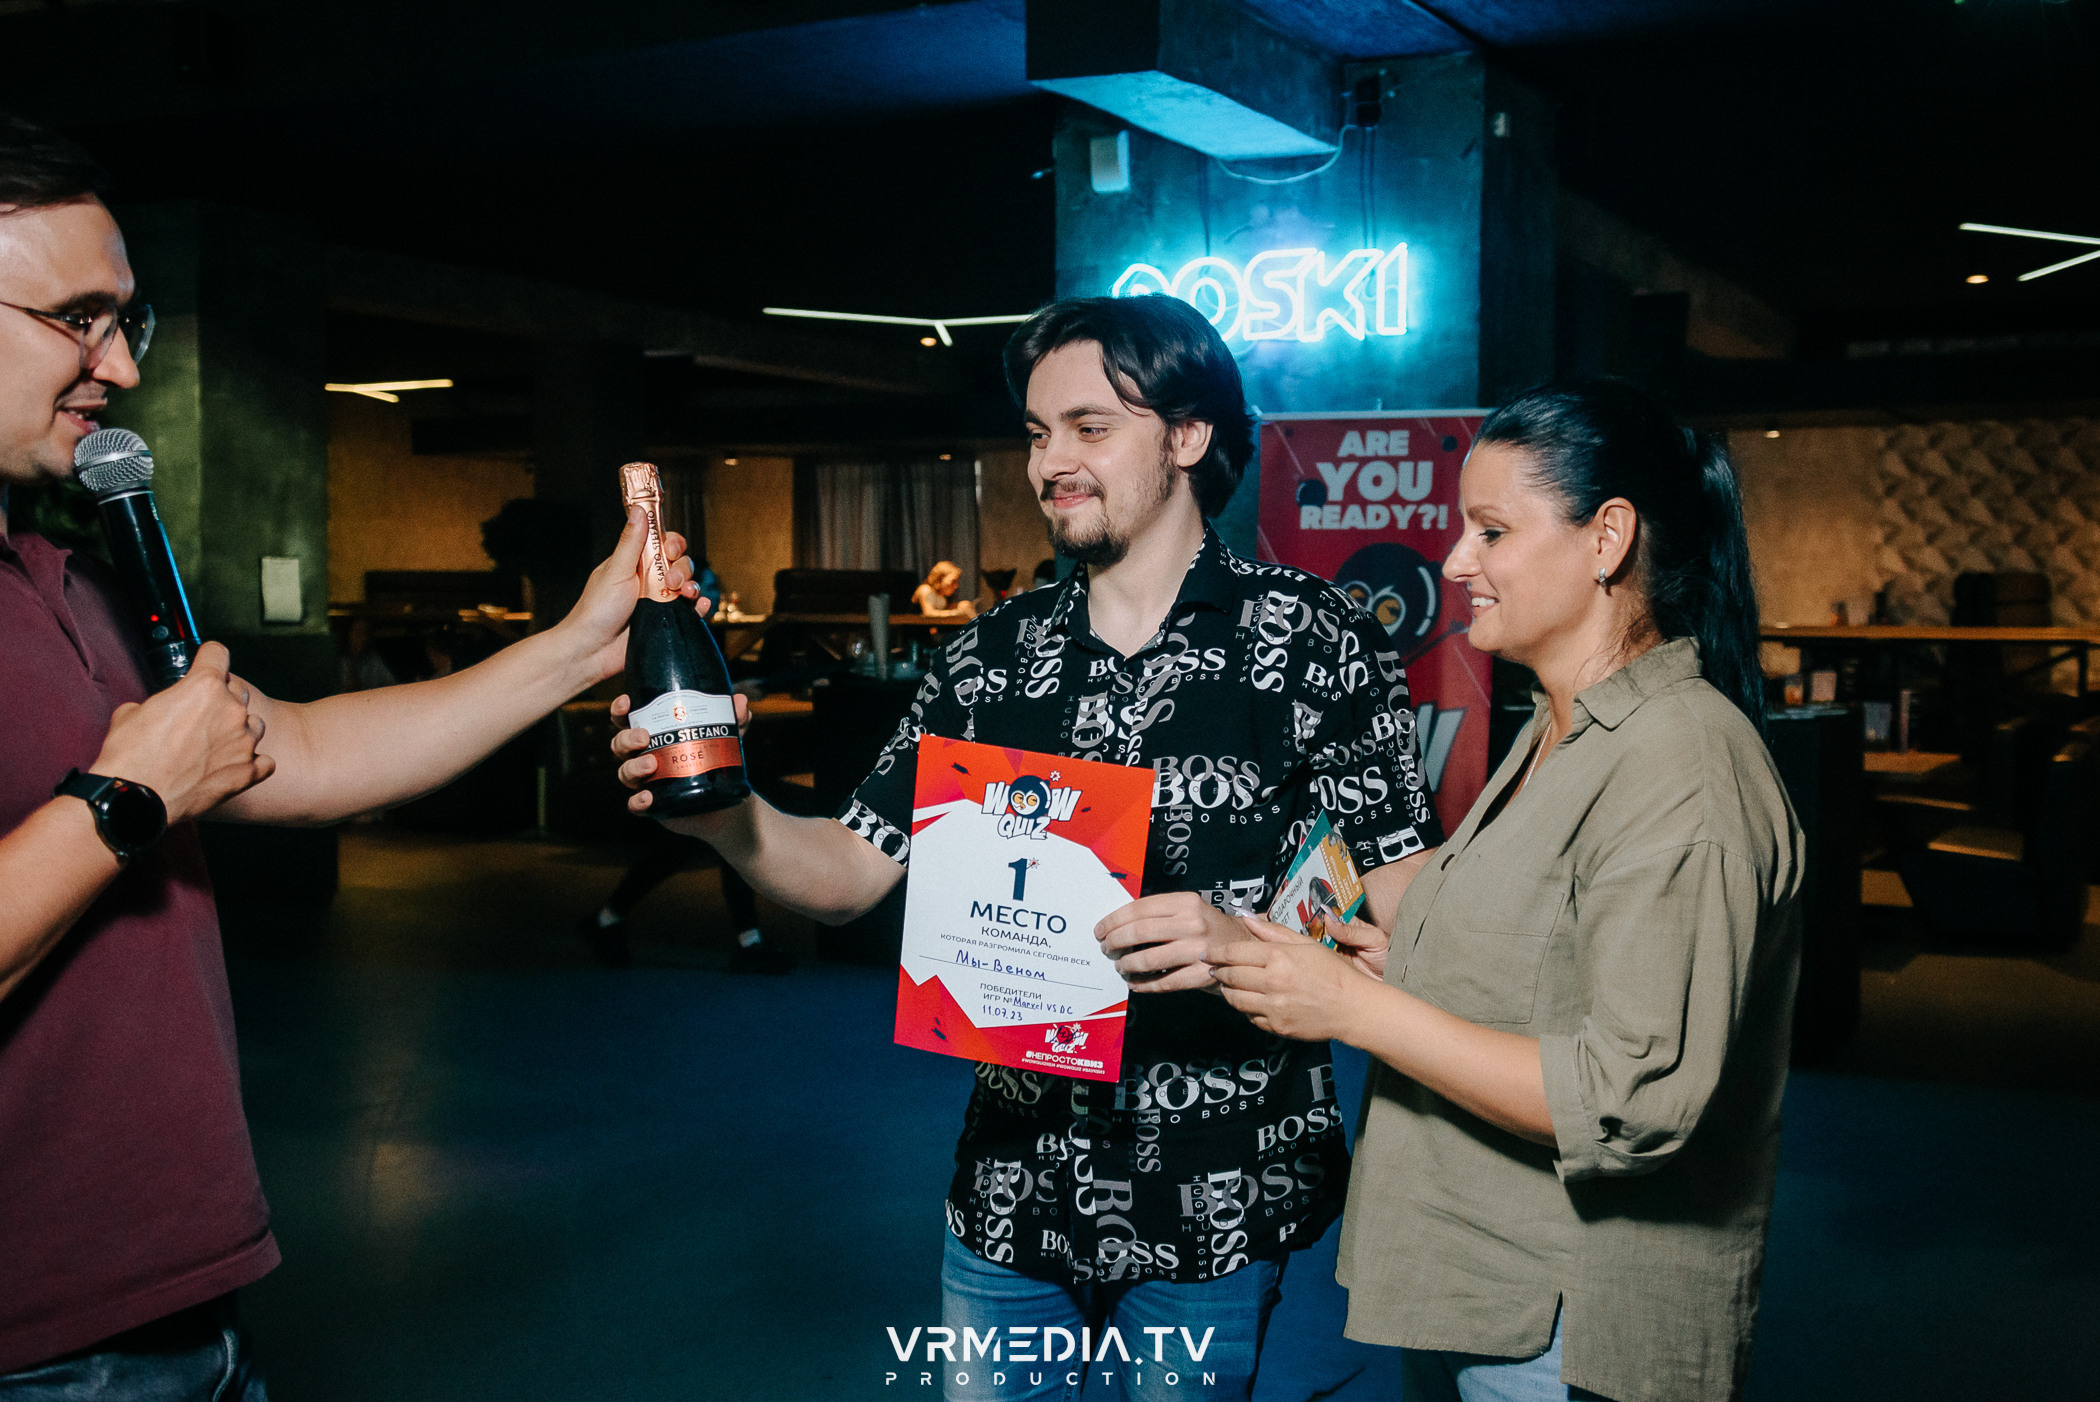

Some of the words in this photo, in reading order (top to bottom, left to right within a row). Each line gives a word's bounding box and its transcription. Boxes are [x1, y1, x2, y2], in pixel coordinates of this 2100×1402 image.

[1338, 430, 1410, 458] ARE
[1316, 460, 1434, 502] YOU
[1300, 504, 1449, 531] READY?!
[678, 725, 729, 742] STEFANO
[672, 751, 704, 764] ROSÉ
[997, 812, 1051, 840] QUIZ
[1007, 857, 1028, 902] 1
[970, 900, 1067, 934] МЕСТО
[940, 933, 977, 946] КОТОРАЯ
[978, 940, 1031, 956] РАЗГРОМИЛА
[1032, 950, 1069, 963] СЕГОДНЯ
[1070, 957, 1091, 967] ВСЕХ
[981, 926, 1052, 949] КОМАНДА,
[980, 982, 1042, 1000] ПОБЕДИТЕЛИ
[983, 993, 1001, 1002] ИГР
[1025, 1049, 1104, 1069] #НЕПРОСТОКВИЗ
